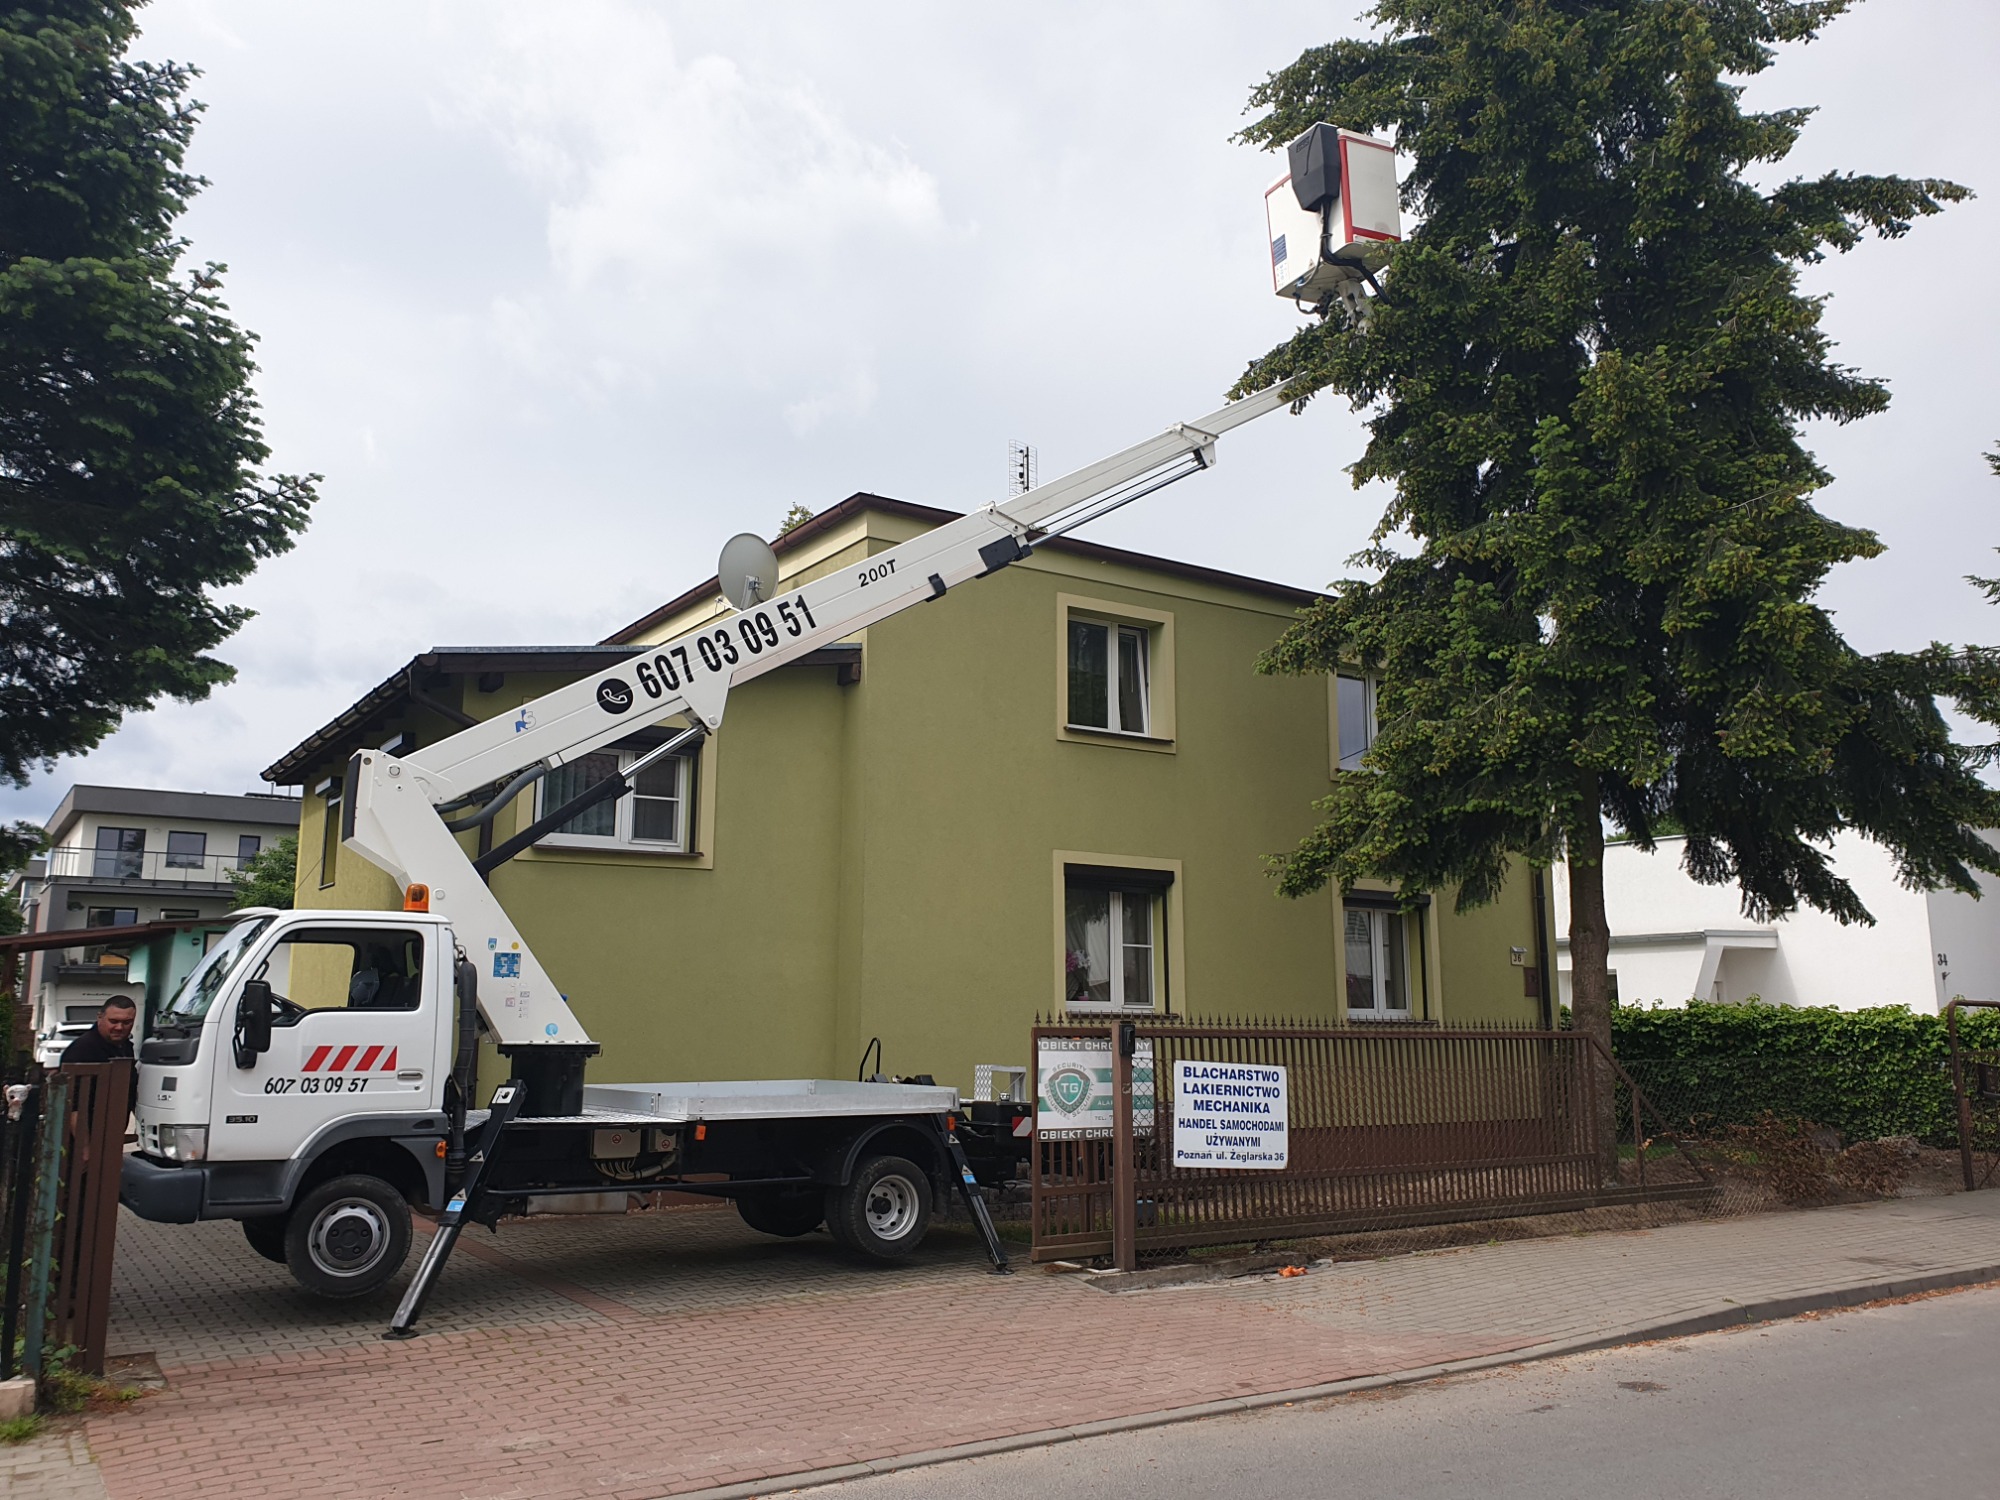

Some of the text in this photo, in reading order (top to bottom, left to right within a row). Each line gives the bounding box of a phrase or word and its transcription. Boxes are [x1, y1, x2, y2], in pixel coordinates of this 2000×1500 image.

[858, 558, 897, 588] 200T
[636, 594, 817, 699] 607 03 09 51
[1937, 953, 1948, 966] 34
[1041, 1041, 1081, 1050] OBIEKT
[1052, 1062, 1087, 1073] SECURITY
[1183, 1066, 1280, 1082] BLACHARSTWO
[264, 1076, 369, 1094] 607 03 09 51
[1060, 1083, 1079, 1093] TG
[1183, 1082, 1280, 1098] LAKIERNICTWO
[1193, 1099, 1270, 1114] MECHANIKA
[1178, 1118, 1284, 1131] HANDEL SAMOCHODAMI
[1040, 1130, 1082, 1140] OBIEKT
[1206, 1132, 1261, 1147] UŻYWANYMI
[1177, 1149, 1285, 1162] Poznań ul. Żeglarska 36
